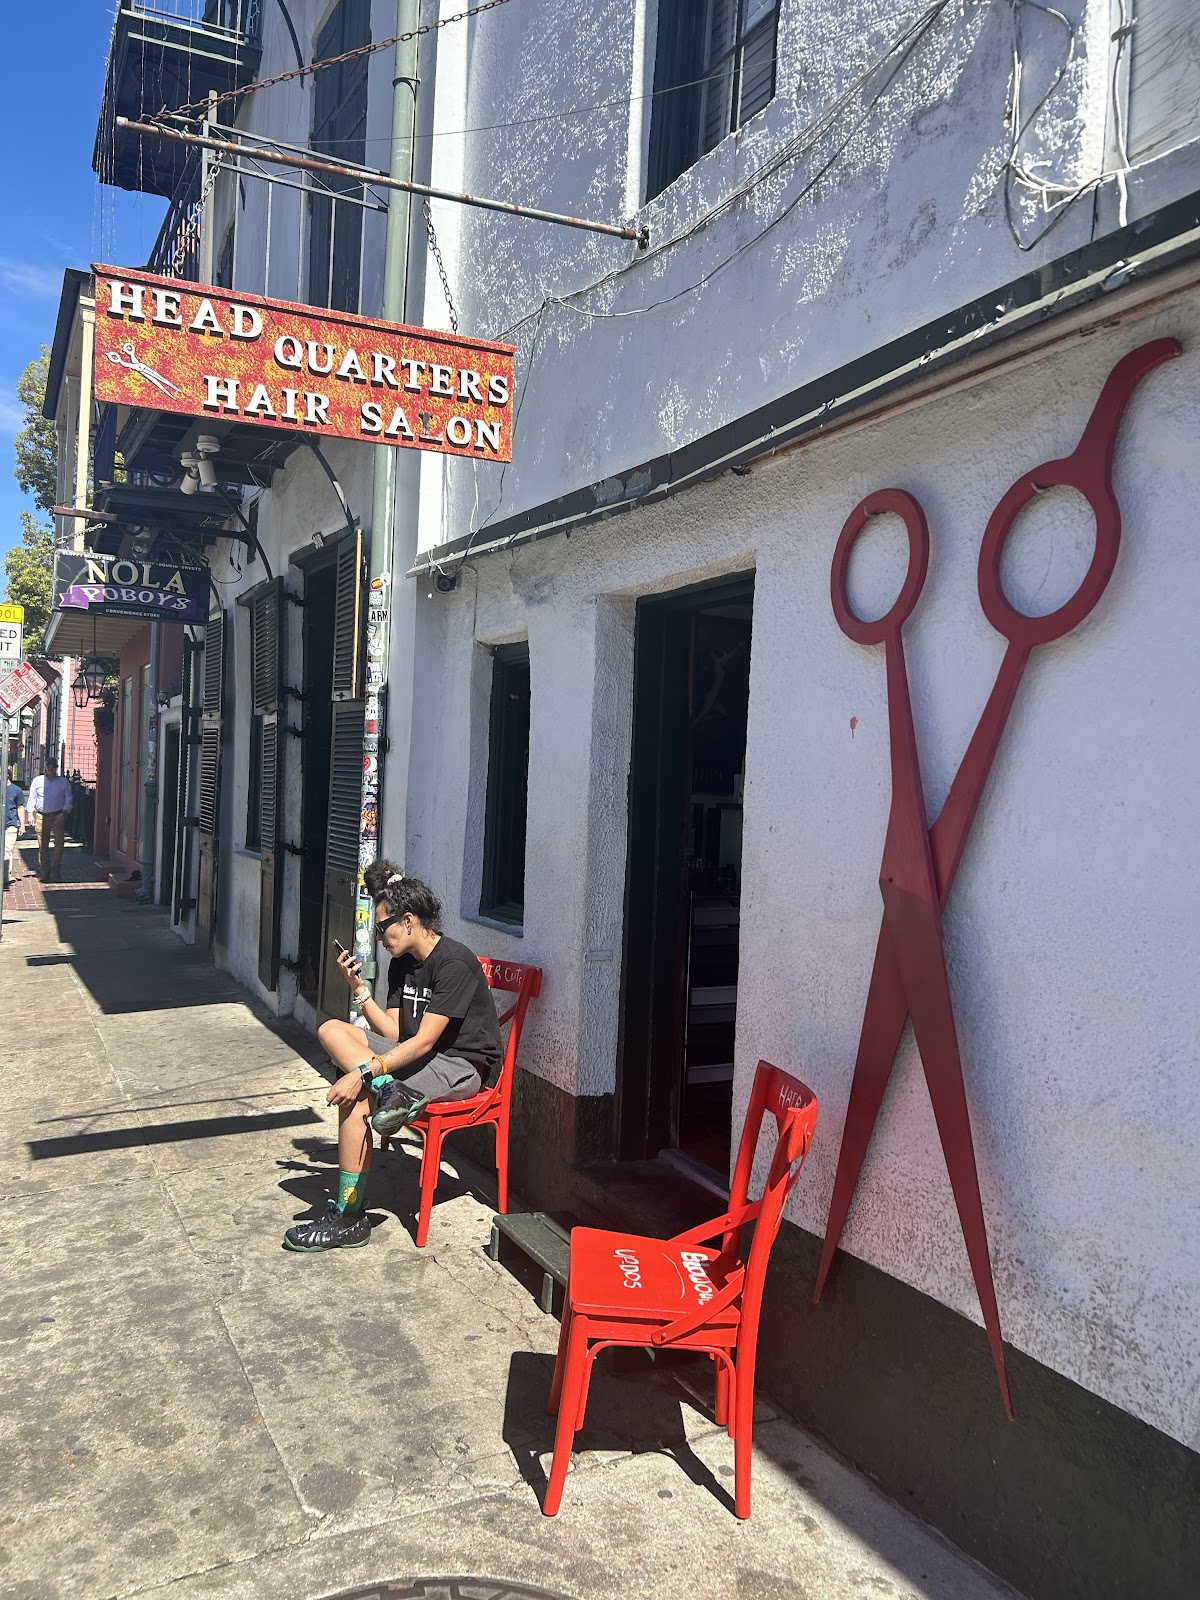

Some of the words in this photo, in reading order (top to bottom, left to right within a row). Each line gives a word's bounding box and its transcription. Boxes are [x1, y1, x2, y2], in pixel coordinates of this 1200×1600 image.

[107, 281, 263, 343] HEAD
[274, 335, 510, 406] QUARTERS
[203, 375, 333, 426] HAIR
[86, 559, 187, 595] NOLA
[80, 586, 192, 610] POBOYS
[105, 608, 143, 617] CONVENIENCE
[9, 683, 22, 697] ZONE
[10, 674, 32, 697] FREIGHT
[680, 1251, 714, 1306] BLOWOU
